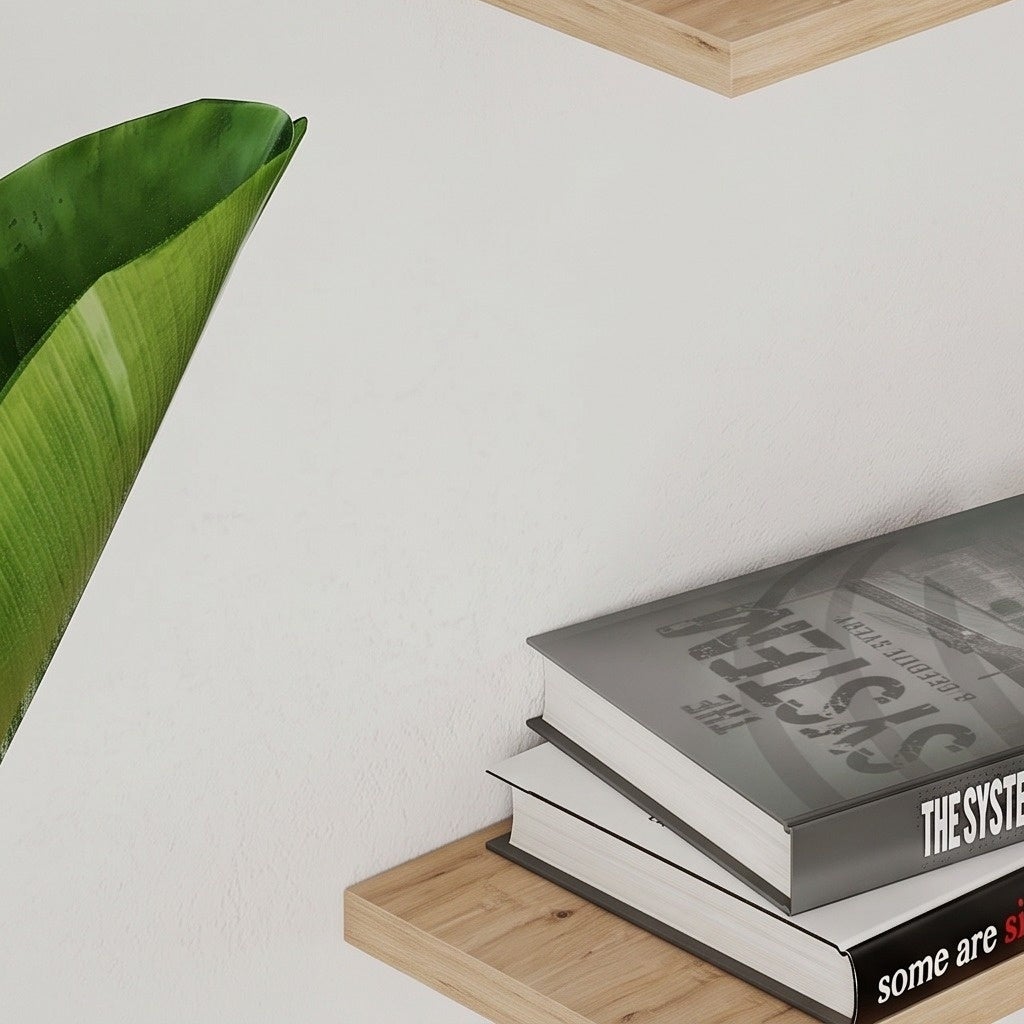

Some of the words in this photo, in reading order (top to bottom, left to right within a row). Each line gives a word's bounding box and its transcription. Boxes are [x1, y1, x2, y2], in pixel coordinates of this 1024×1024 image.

[656, 603, 977, 774] SYSTEM
[681, 693, 763, 736] THE
[921, 791, 962, 858] THE
[877, 948, 949, 1004] some
[956, 925, 997, 967] are
